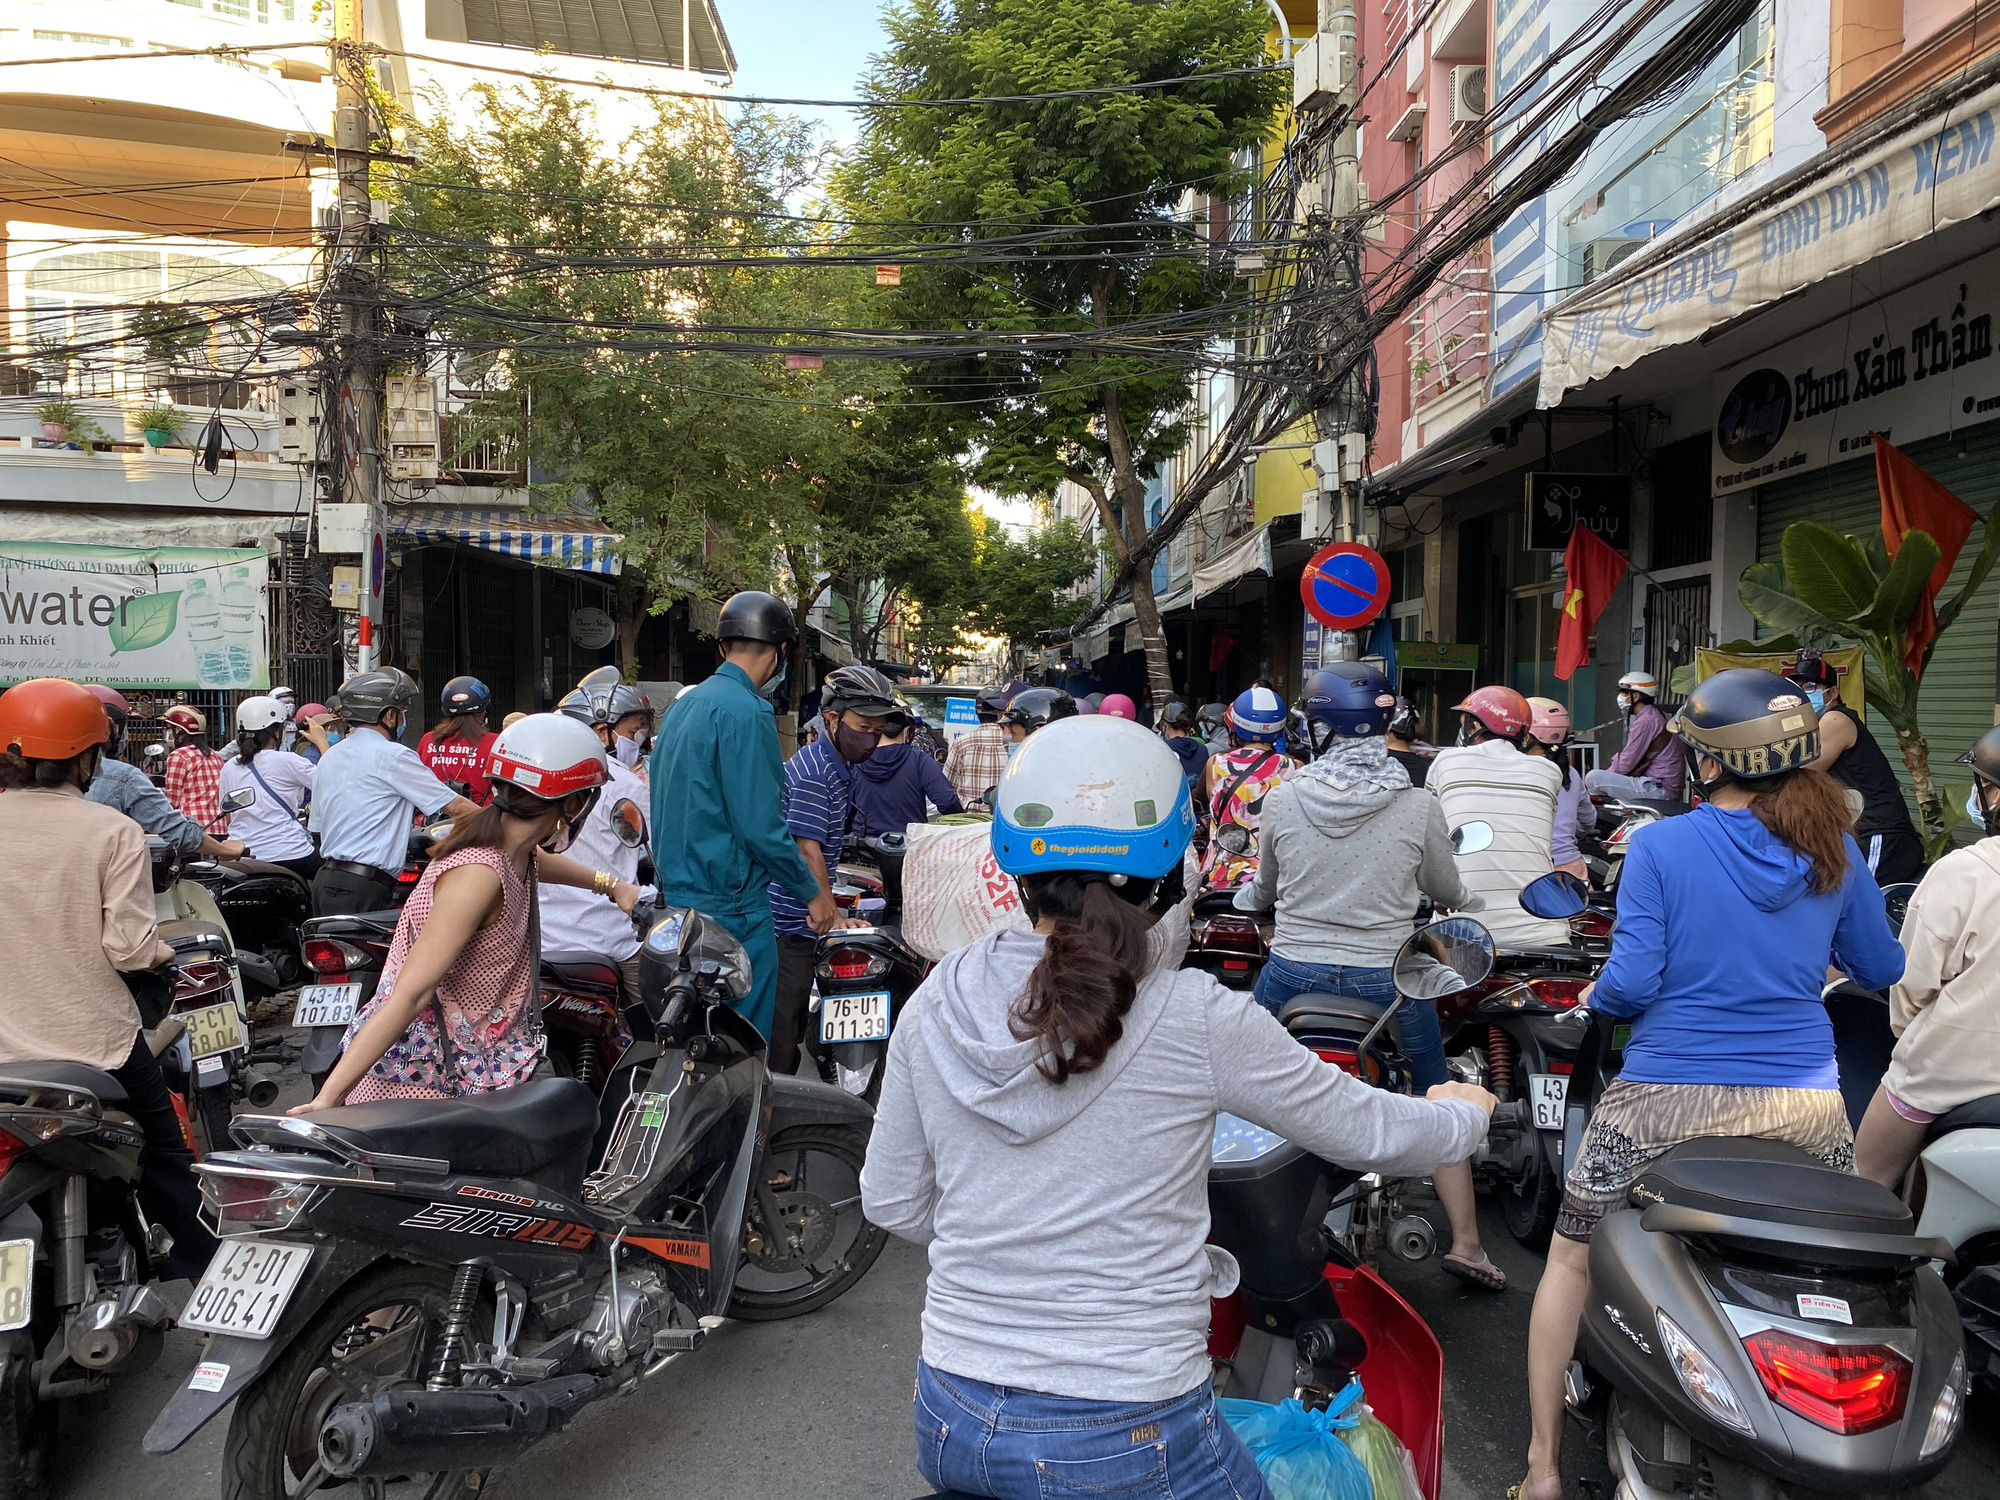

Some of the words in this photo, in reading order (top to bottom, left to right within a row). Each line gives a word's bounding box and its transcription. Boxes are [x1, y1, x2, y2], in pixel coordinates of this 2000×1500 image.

[1826, 162, 1890, 233] DÂN
[1793, 366, 1850, 422] Phun
[1853, 334, 1907, 402] Xăm
[1911, 283, 1992, 382] Thẩm
[0, 586, 136, 627] water
[20, 634, 57, 646] Khiết
[1049, 843, 1130, 857] thegioididong
[982, 847, 1018, 912] 52F
[308, 986, 351, 1005] 43-AA
[300, 1004, 353, 1024] 107.83
[833, 997, 879, 1019] 76-U1
[187, 1008, 227, 1034] 3-C1
[825, 1017, 886, 1041] 011.39
[1543, 1079, 1564, 1101] 43
[1537, 1103, 1562, 1126] 64
[457, 1185, 536, 1208] SIRIUS
[534, 1200, 567, 1212] RC
[665, 1242, 701, 1259] YAMAHA
[221, 1245, 293, 1287] 43-D1
[190, 1284, 280, 1331] 906.41
